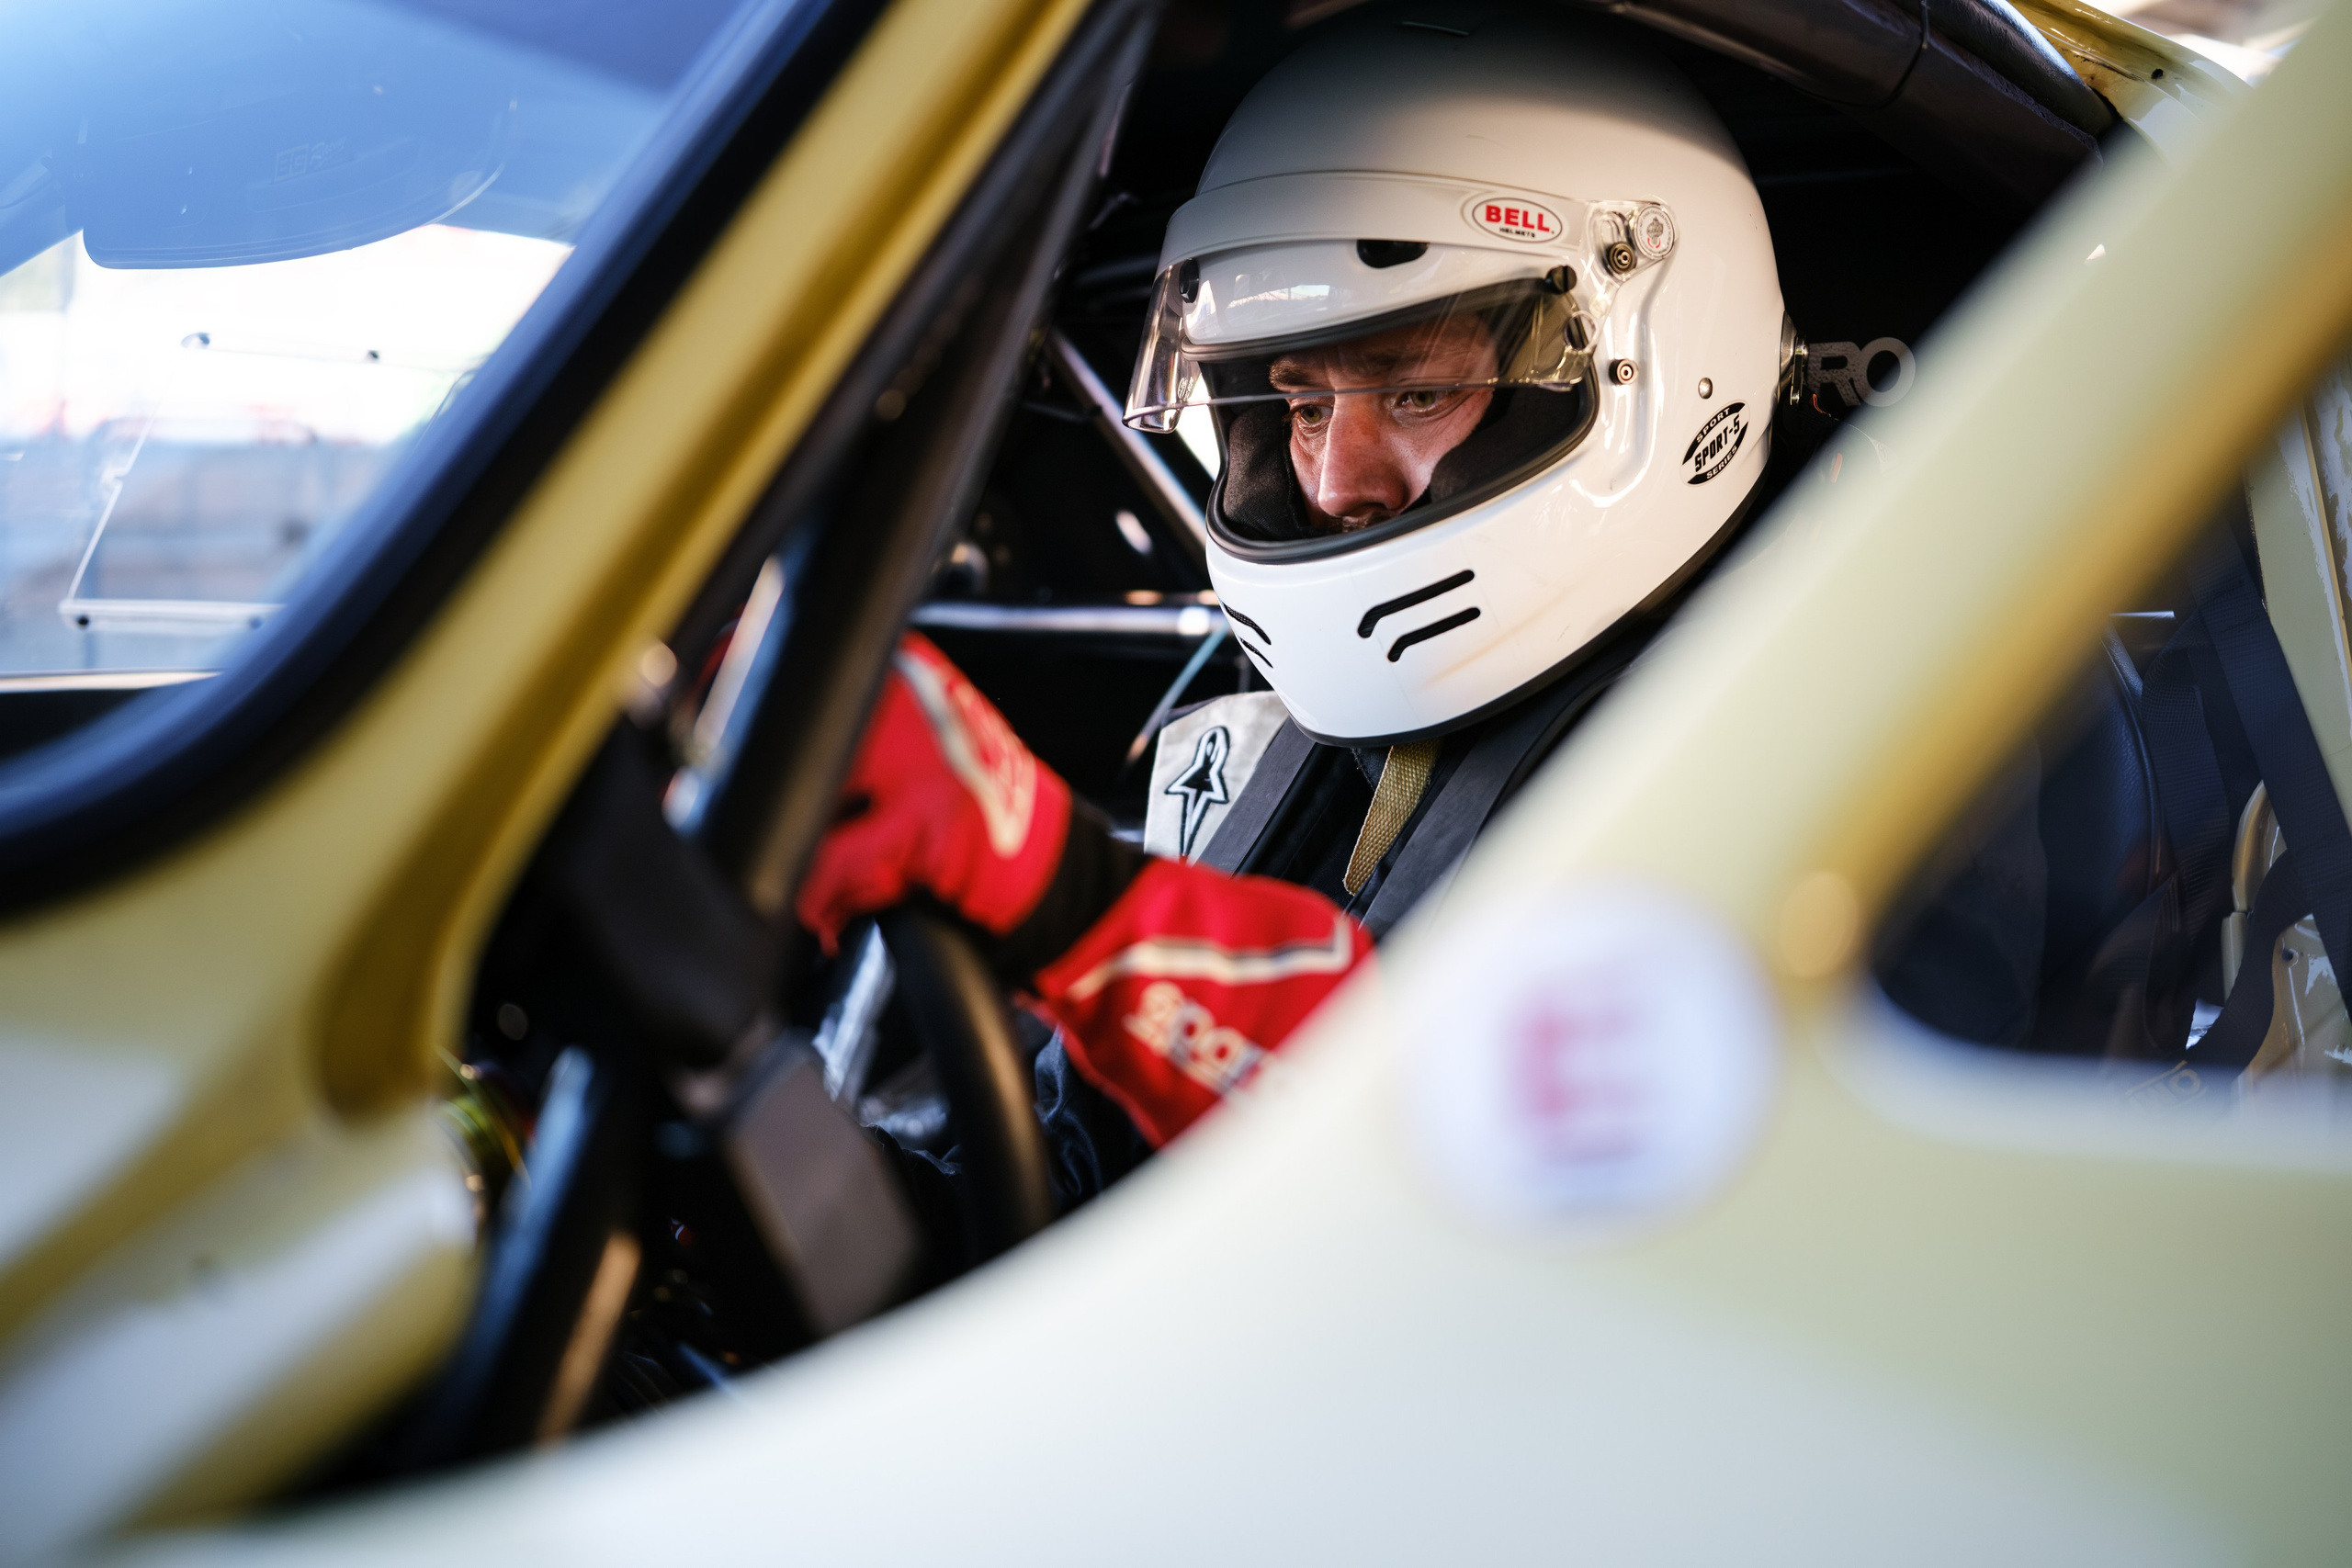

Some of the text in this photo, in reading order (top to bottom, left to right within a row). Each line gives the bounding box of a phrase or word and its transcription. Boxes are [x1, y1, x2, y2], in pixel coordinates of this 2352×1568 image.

[1486, 205, 1550, 231] BELL
[1694, 413, 1740, 472] SPORT-5
[1696, 407, 1730, 443] SPORT
[1706, 445, 1737, 479] SERIES
